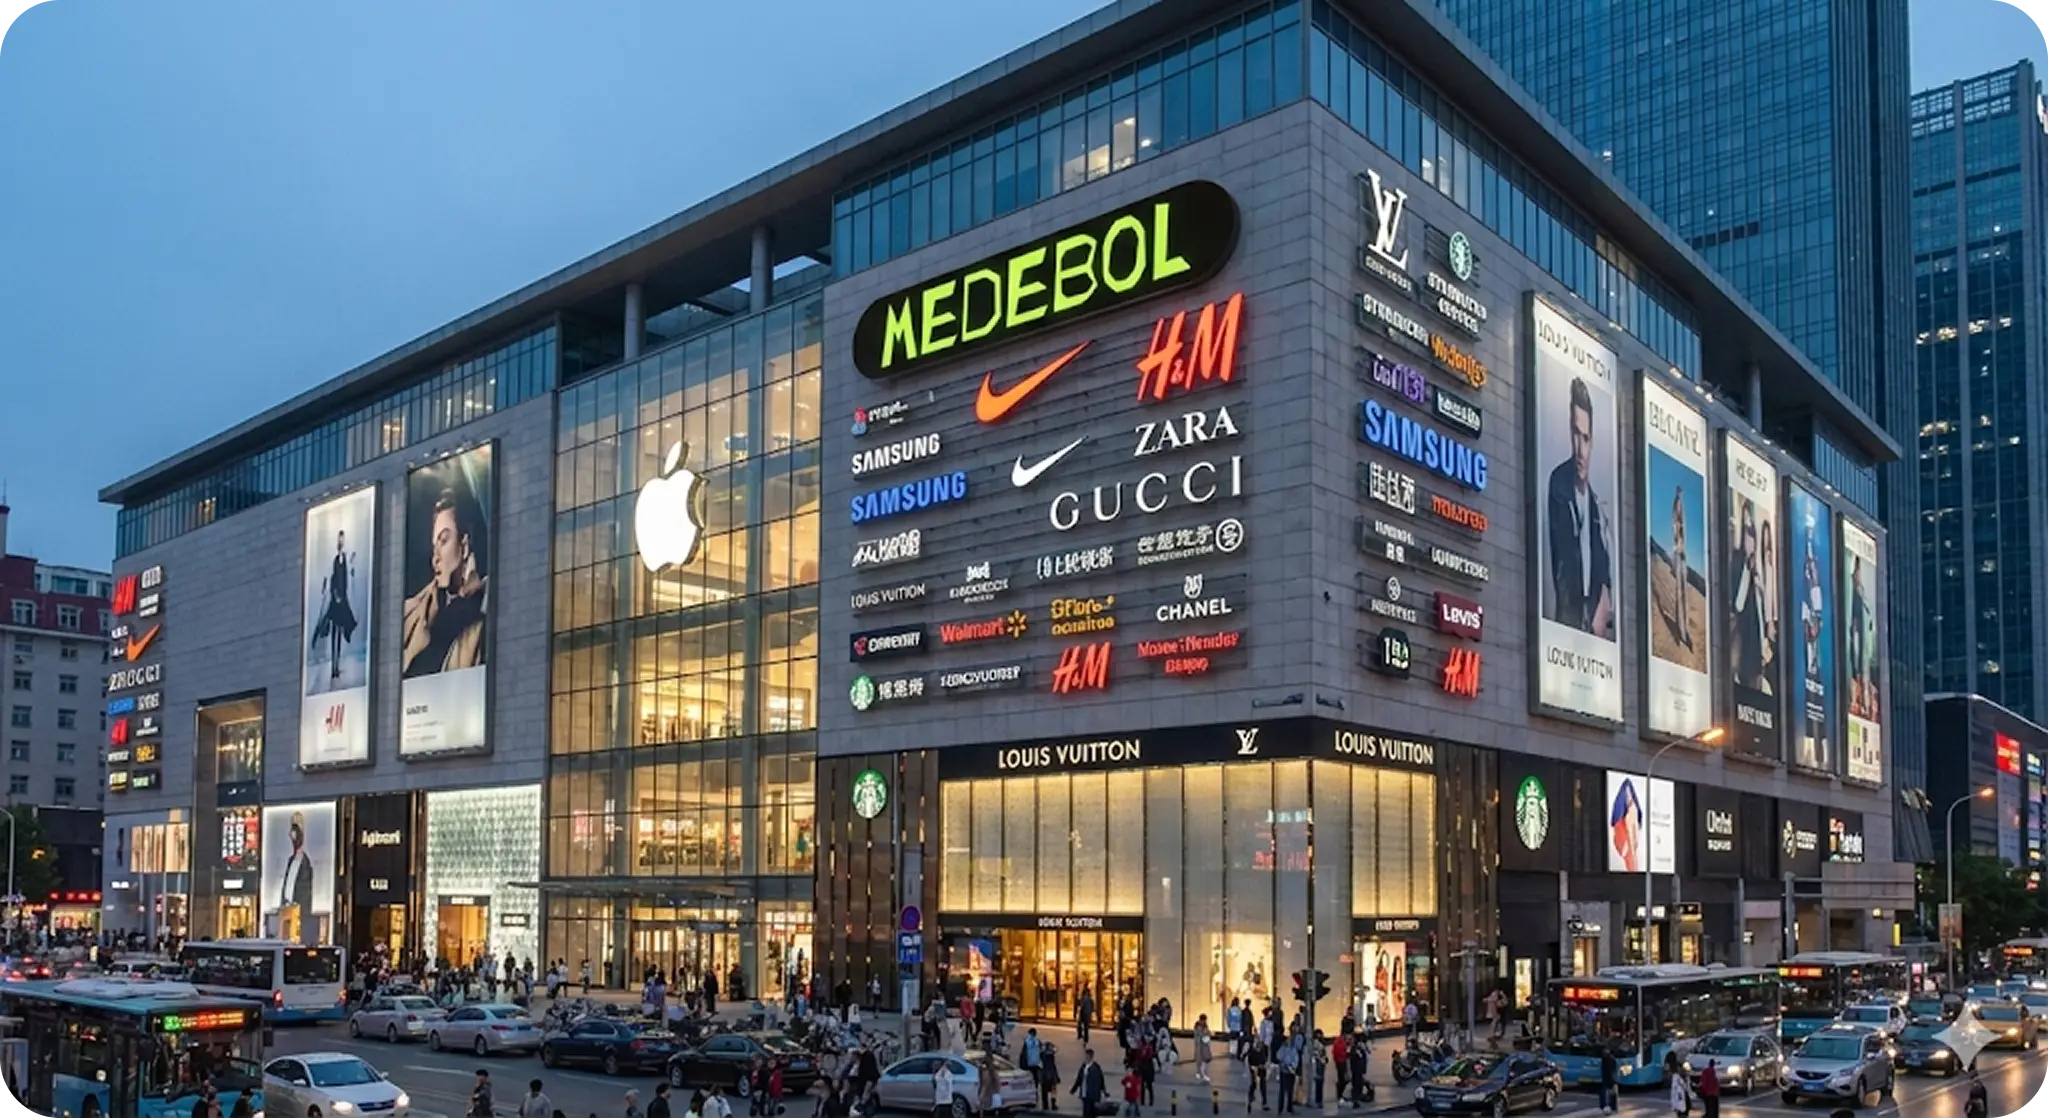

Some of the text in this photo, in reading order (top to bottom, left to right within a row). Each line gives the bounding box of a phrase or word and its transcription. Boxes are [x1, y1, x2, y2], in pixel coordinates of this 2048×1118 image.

[881, 202, 1191, 369] MEDEBOL
[1136, 292, 1244, 401] H&M
[851, 432, 940, 475] SAMSUNG
[1134, 406, 1238, 457] ZARA
[1364, 399, 1487, 491] SAMSUNG
[851, 470, 967, 523] SAMSUNG
[1050, 455, 1242, 530] GUCCI
[939, 617, 1005, 643] Walmart
[1156, 598, 1232, 621] CHANEL
[1052, 641, 1111, 694] H&M
[998, 739, 1140, 769] LOUIS VUITTON
[1335, 730, 1434, 765] LOUIS VUITTON
